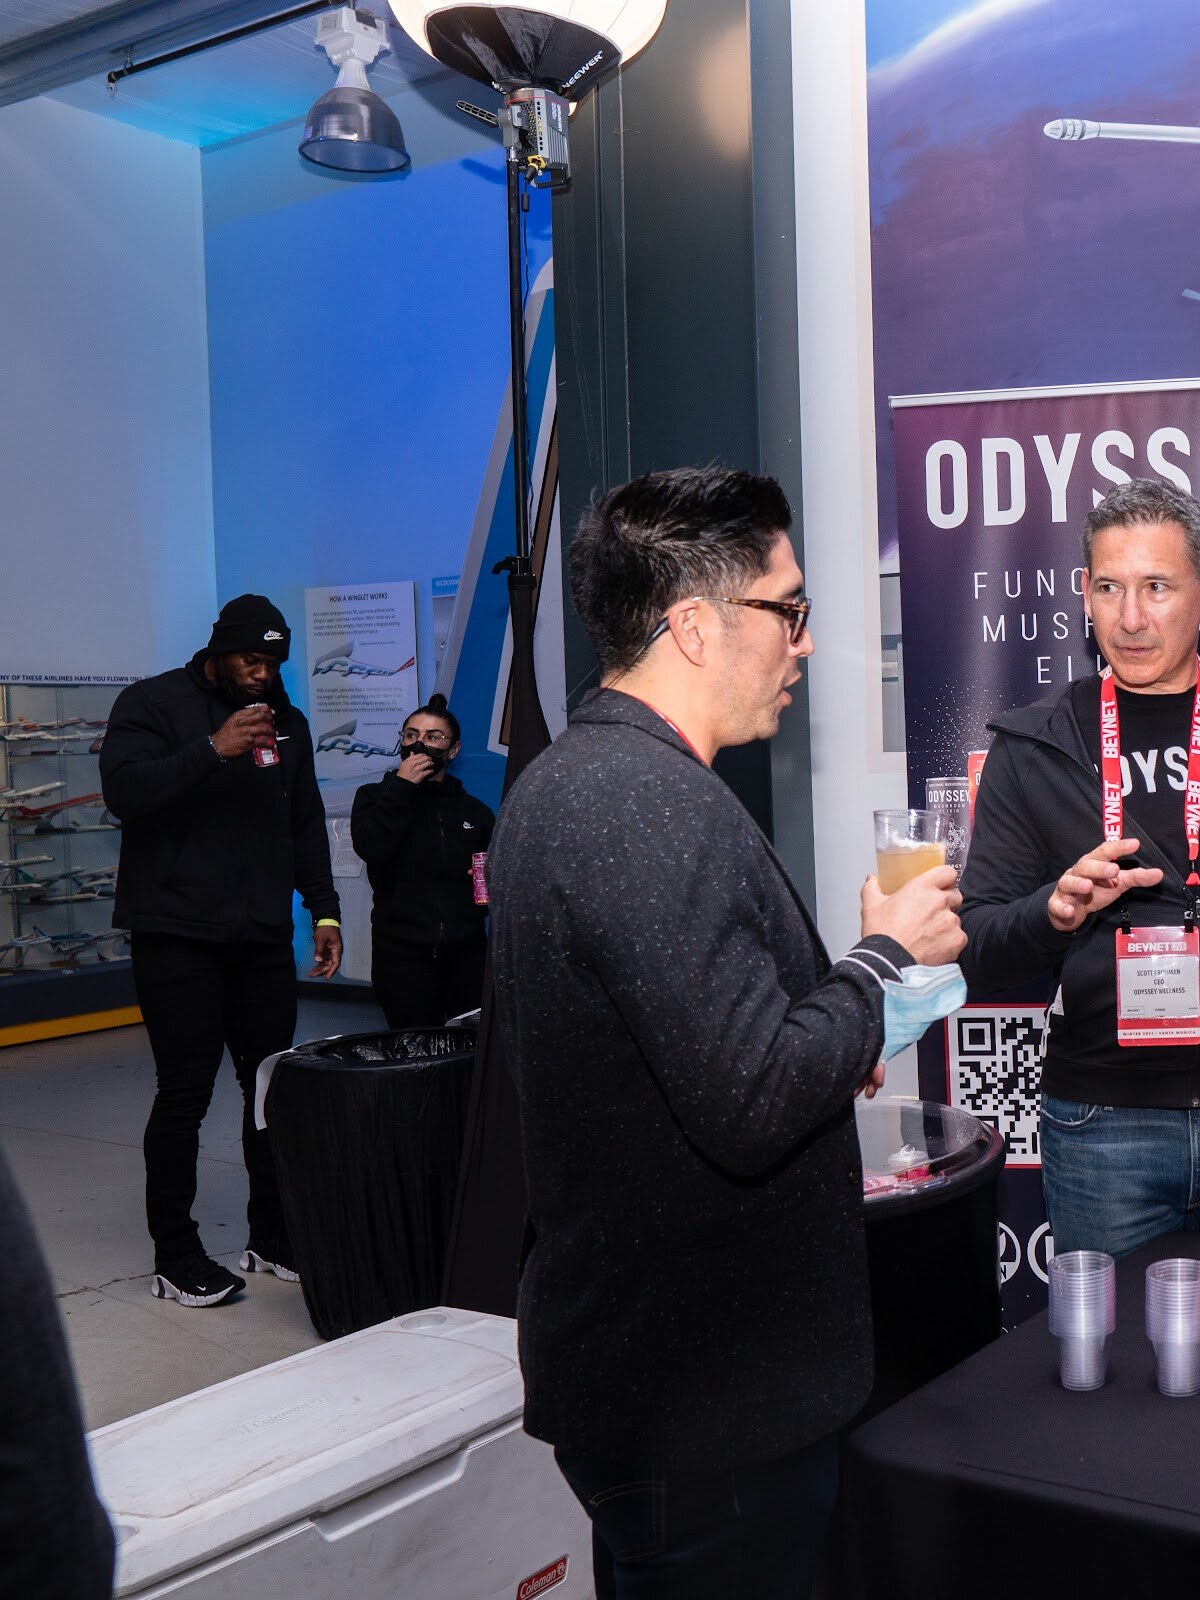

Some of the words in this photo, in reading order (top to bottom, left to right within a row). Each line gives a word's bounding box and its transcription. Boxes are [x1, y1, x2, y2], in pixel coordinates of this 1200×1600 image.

[561, 51, 603, 89] NEEWER
[370, 592, 388, 600] WORKS
[1102, 700, 1118, 759] BEVNET
[928, 789, 970, 803] ODYSSEY
[1128, 942, 1171, 952] BEVNET
[1137, 969, 1153, 977] SCOTT
[520, 1569, 557, 1598] Coleman
